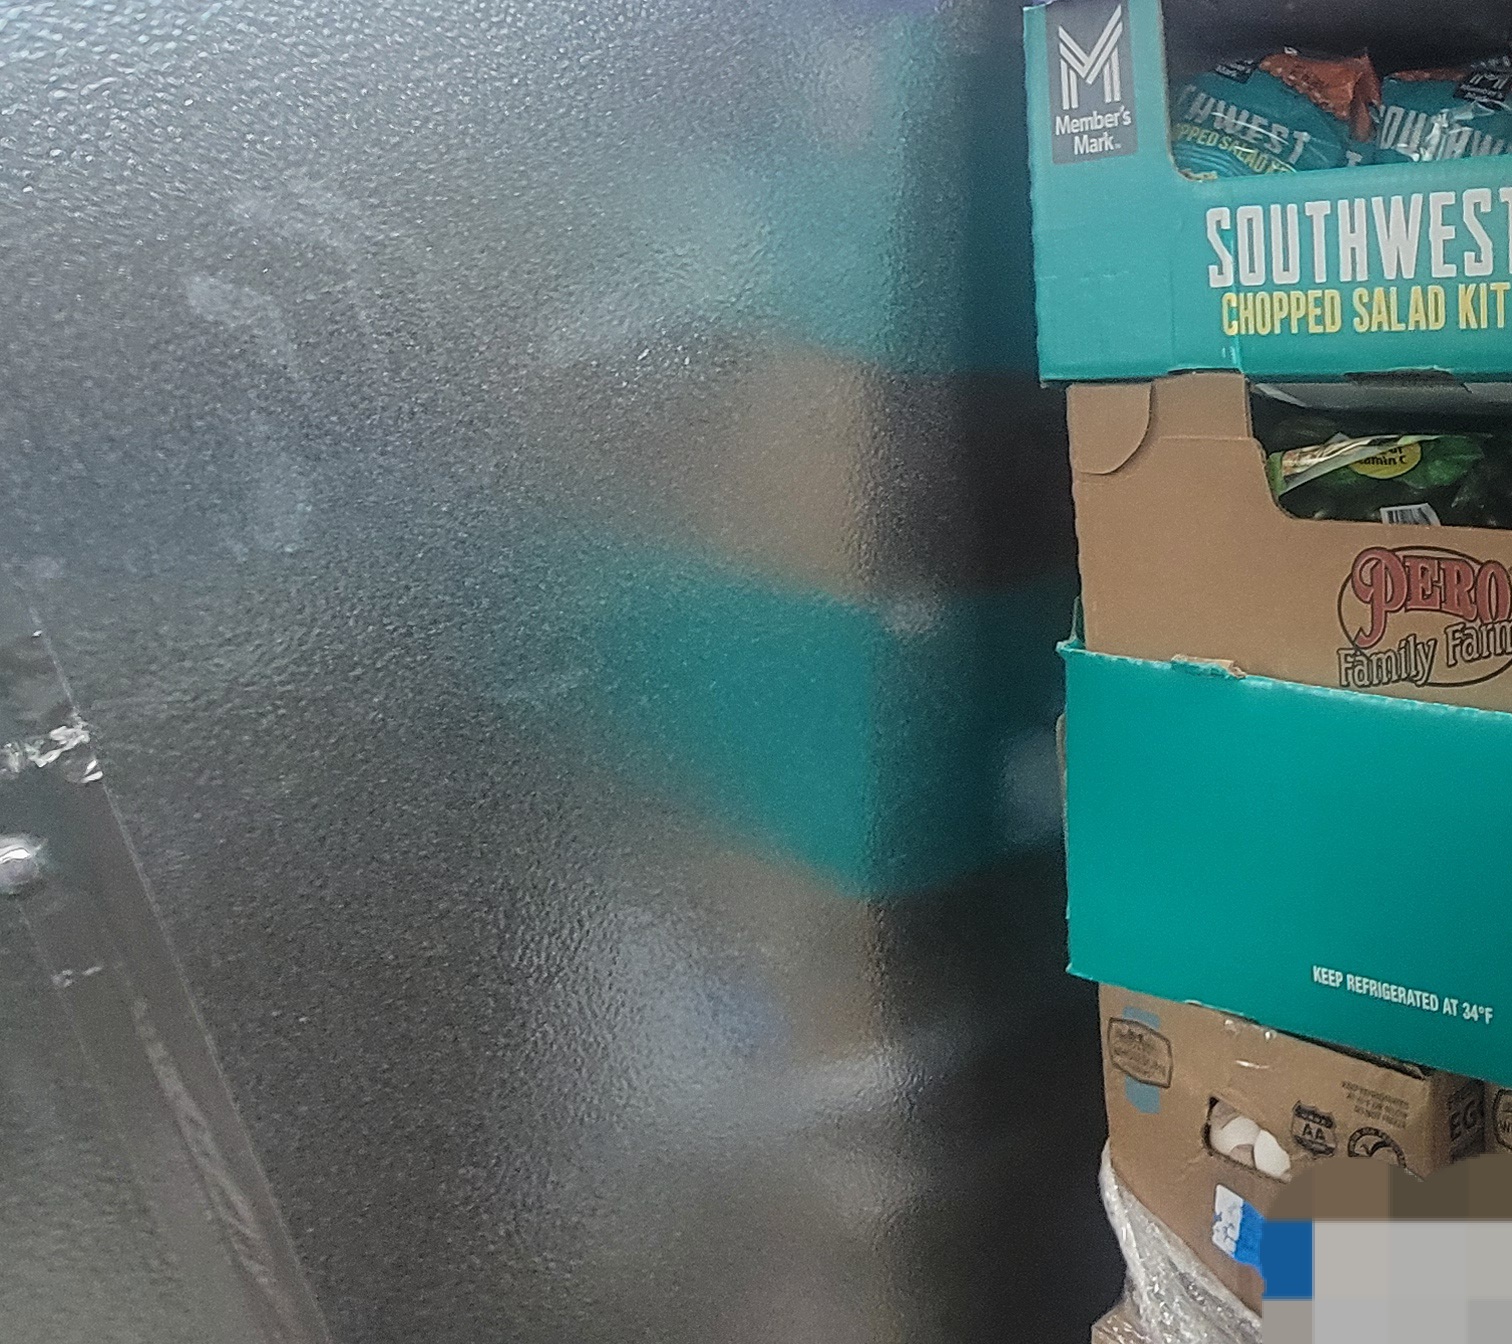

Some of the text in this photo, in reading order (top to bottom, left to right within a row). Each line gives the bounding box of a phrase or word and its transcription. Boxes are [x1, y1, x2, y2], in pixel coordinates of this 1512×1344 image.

[1055, 105, 1132, 136] Member's
[1074, 132, 1115, 155] Mark
[1222, 281, 1511, 336] CHOPPED SALAD KIT
[1351, 547, 1512, 649] PERO
[1337, 633, 1437, 687] Family
[1313, 965, 1493, 1025] KEEP REFRIGERATED AT 34°F
